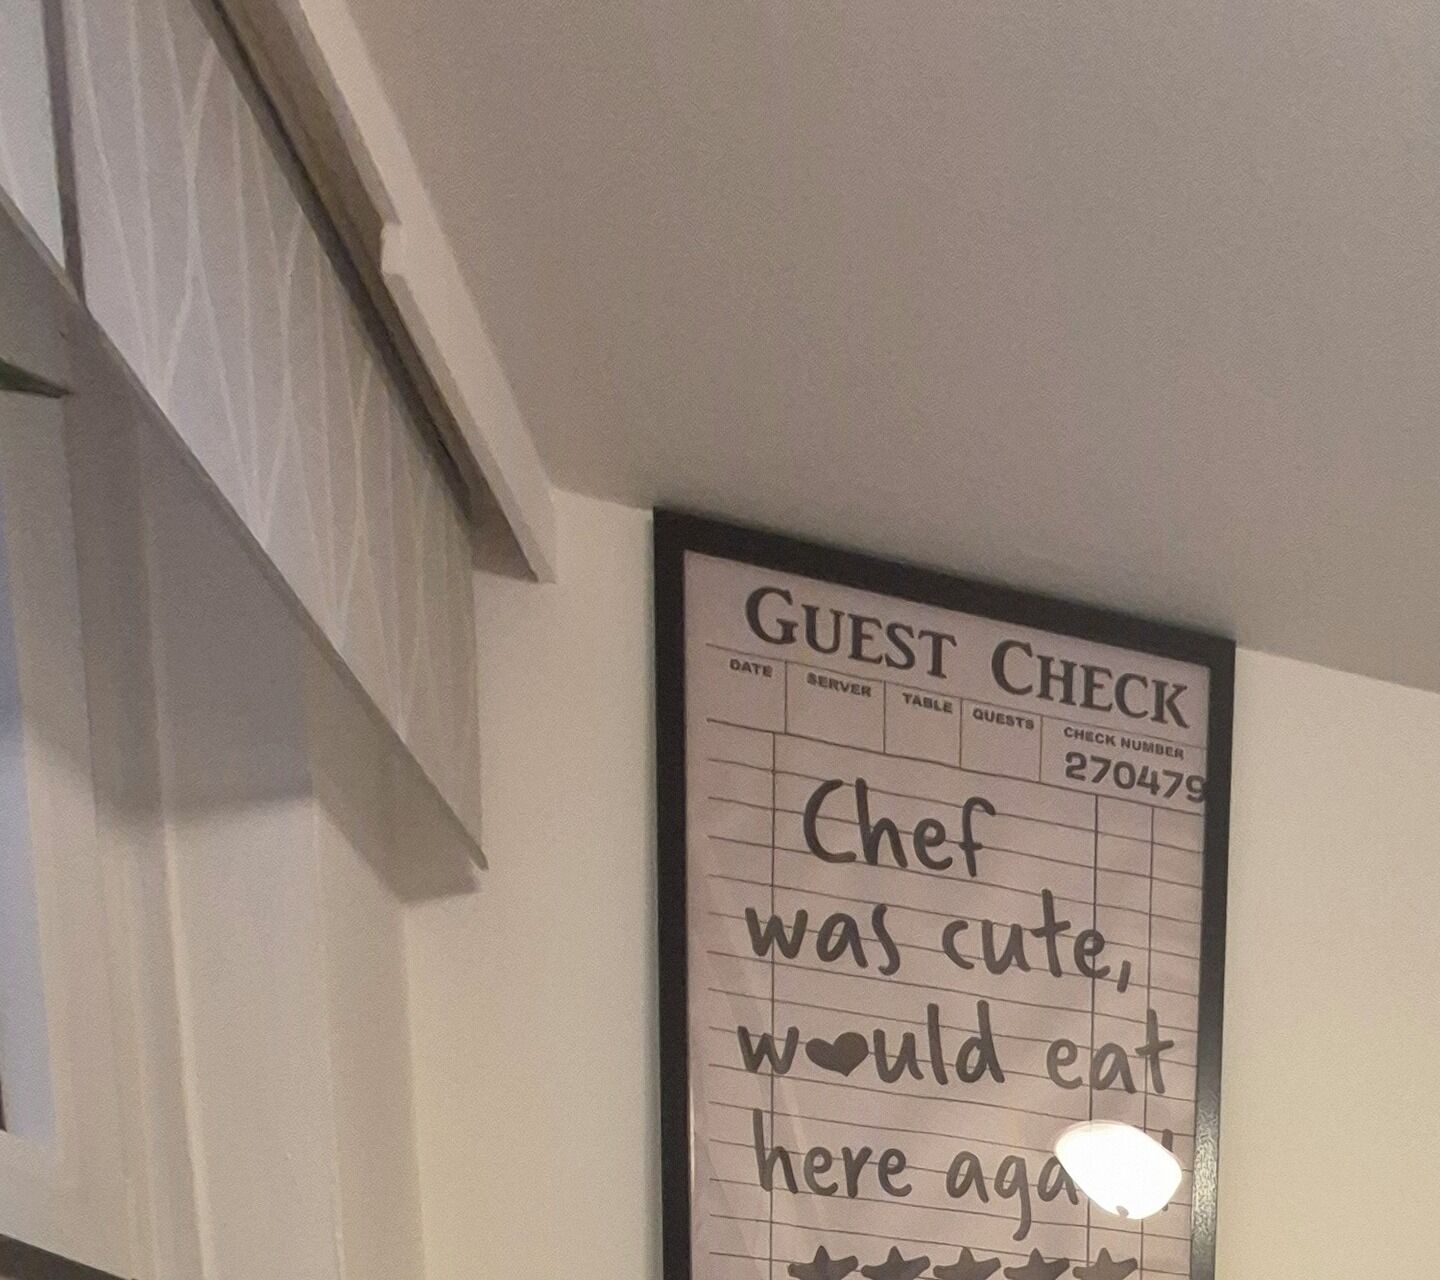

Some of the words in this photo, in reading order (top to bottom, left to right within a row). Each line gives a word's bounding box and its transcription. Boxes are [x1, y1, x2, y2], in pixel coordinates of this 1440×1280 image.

[730, 658, 774, 678] DATE
[745, 585, 958, 680] GUEST
[991, 638, 1191, 729] CHECK
[806, 672, 872, 698] SERVER
[902, 692, 954, 714] TABLE
[1063, 726, 1117, 748] CHECK
[1120, 737, 1185, 761] NUMBER
[1065, 751, 1208, 804] 270479
[804, 777, 996, 877] Chef
[745, 903, 900, 976] was
[942, 888, 1132, 993] cute,
[1046, 1008, 1175, 1094] eat
[752, 1108, 913, 1199] here
